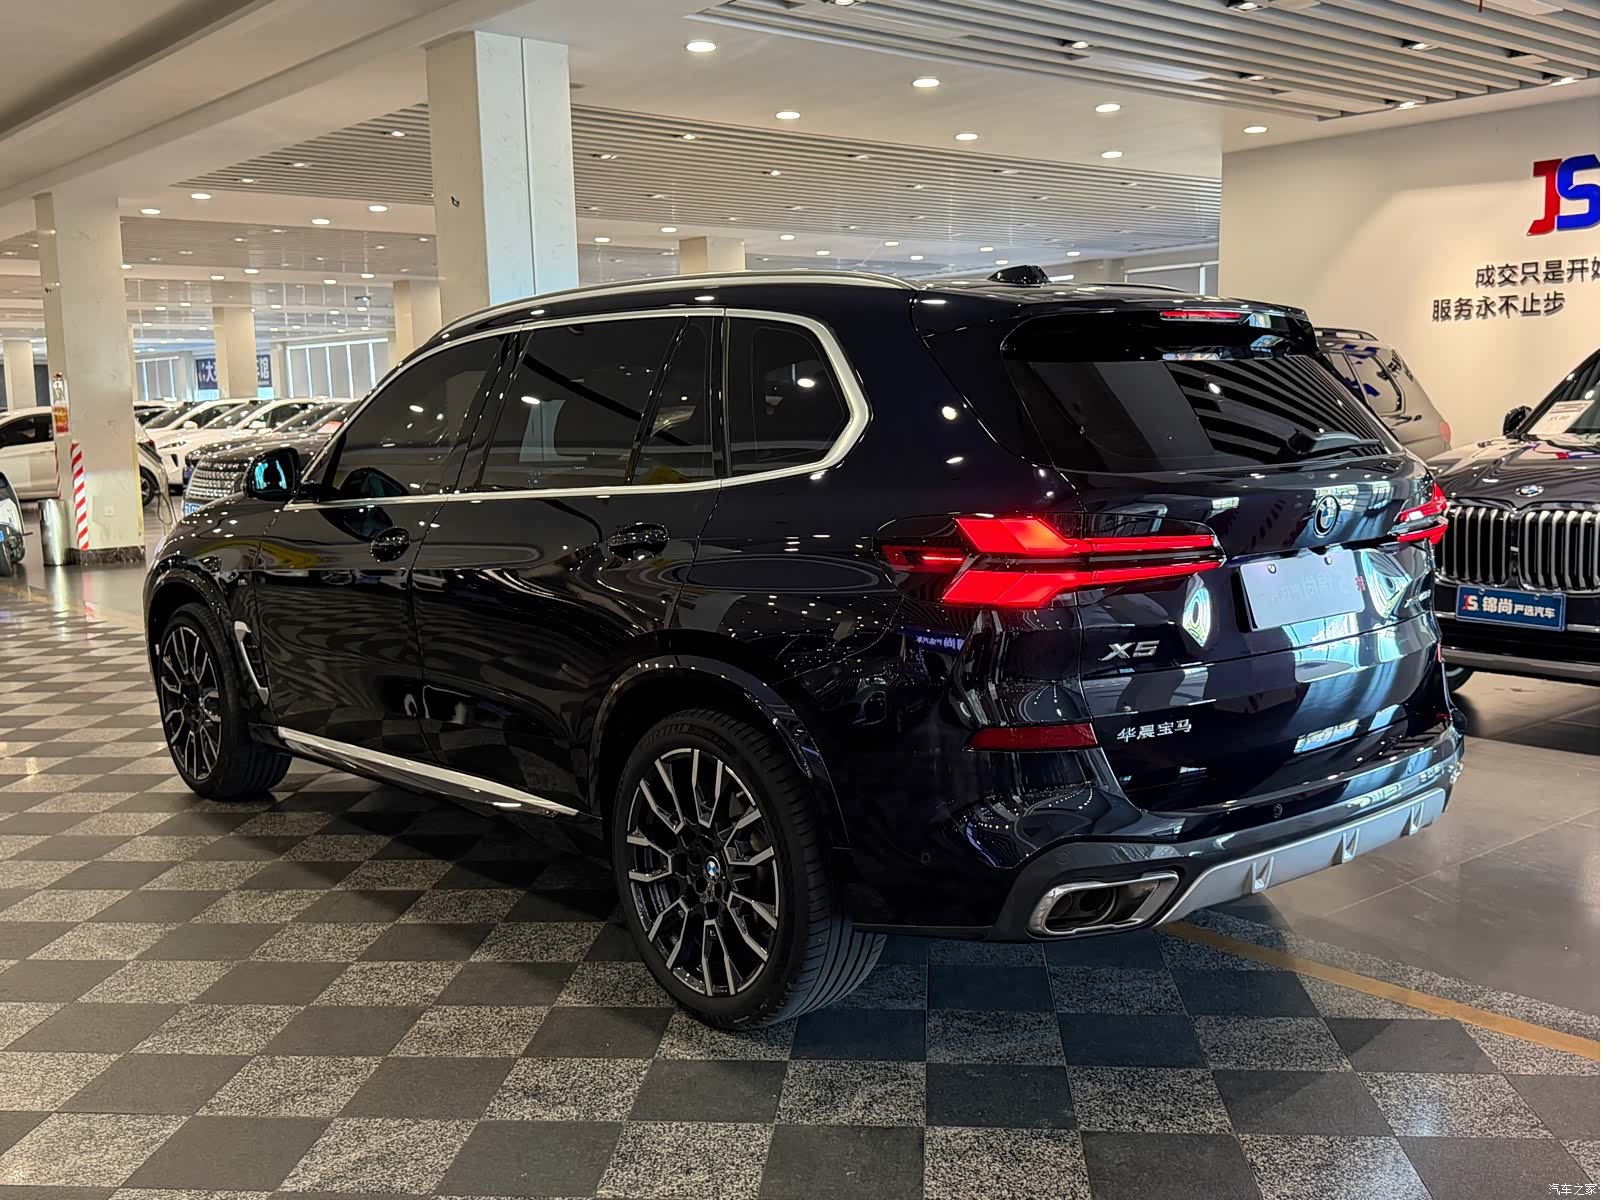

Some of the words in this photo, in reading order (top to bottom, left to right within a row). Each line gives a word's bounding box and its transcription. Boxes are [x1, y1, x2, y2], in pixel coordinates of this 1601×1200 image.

[1526, 154, 1601, 236] JS
[1432, 291, 1565, 322] 服务永不止步
[1098, 640, 1160, 661] X5
[1117, 719, 1192, 742] 华晨宝马
